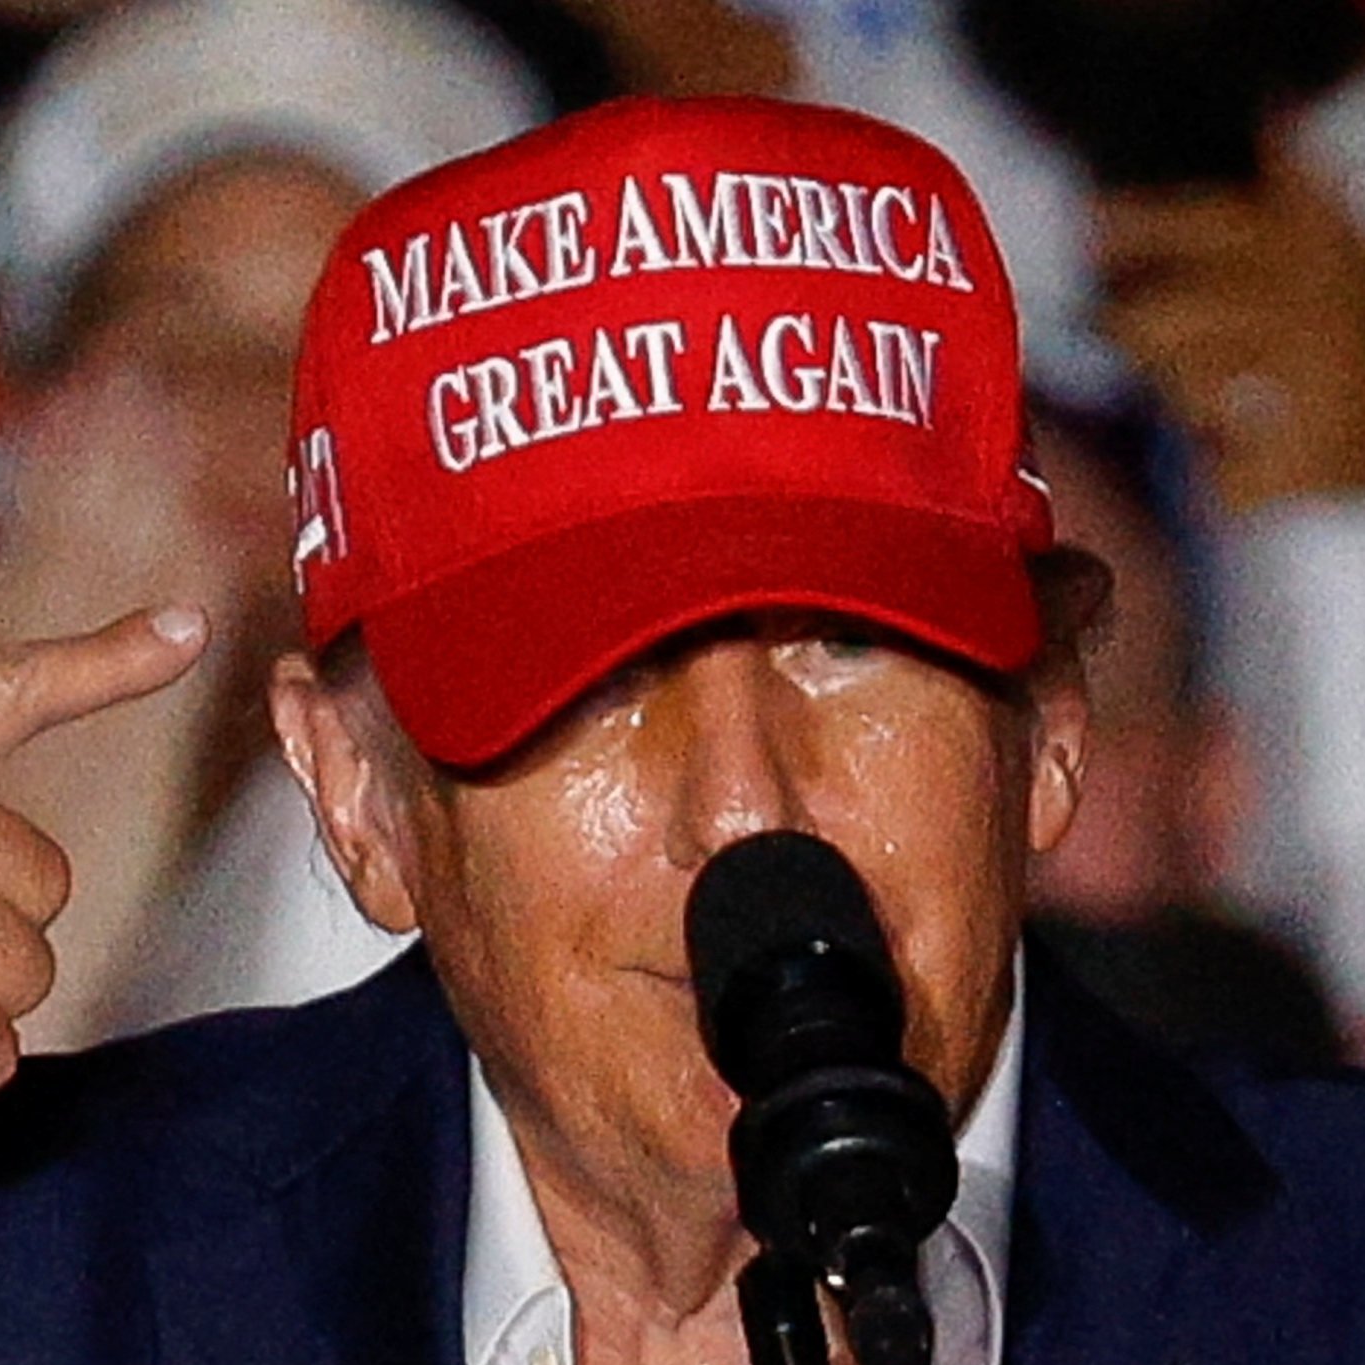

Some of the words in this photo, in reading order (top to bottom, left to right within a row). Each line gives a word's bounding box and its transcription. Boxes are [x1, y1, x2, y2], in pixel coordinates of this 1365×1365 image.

[361, 189, 597, 345] MAKE
[608, 171, 975, 293] AMERICA
[426, 327, 685, 473] GREAT
[706, 311, 941, 431] AGAIN
